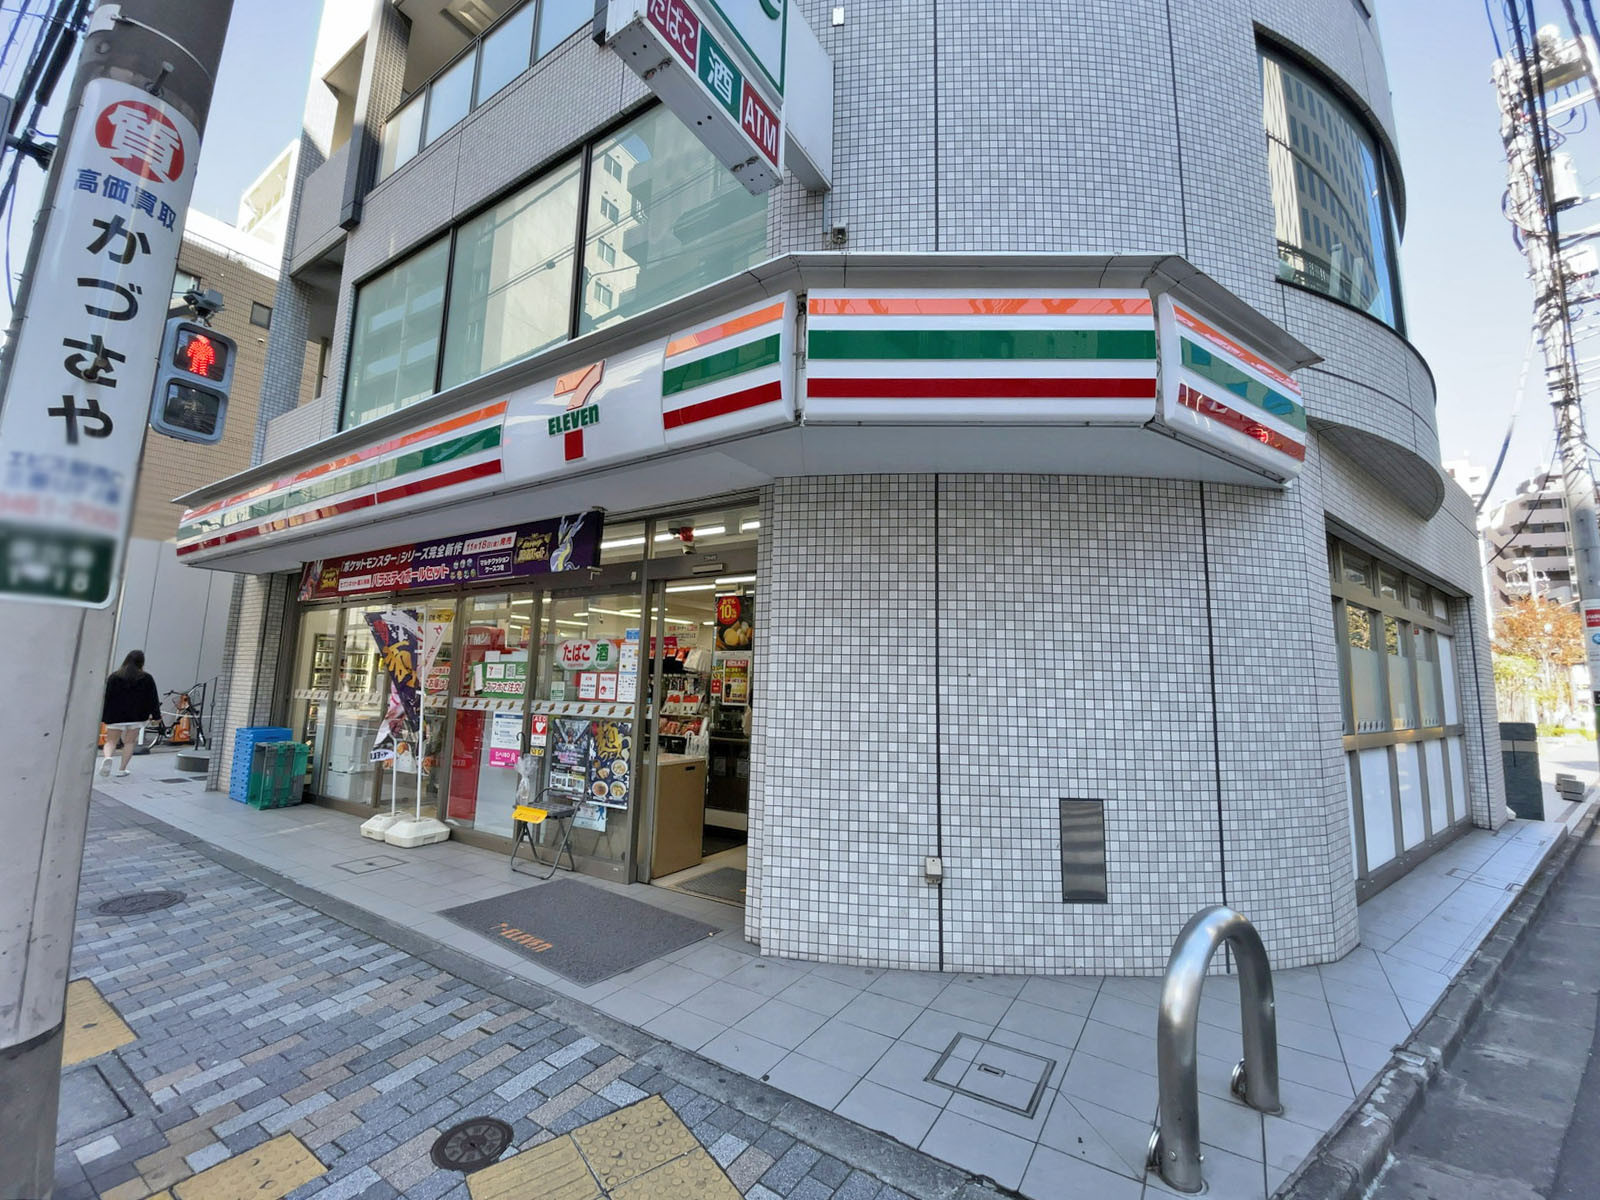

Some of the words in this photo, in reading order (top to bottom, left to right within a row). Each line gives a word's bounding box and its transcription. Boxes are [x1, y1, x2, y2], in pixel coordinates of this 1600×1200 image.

[708, 46, 734, 106] 酒
[107, 104, 181, 182] 質
[744, 95, 777, 158] ATM
[74, 168, 178, 232] 高価買取
[47, 214, 152, 445] かづさや
[563, 643, 590, 661] たばこ
[596, 643, 609, 661] 酒
